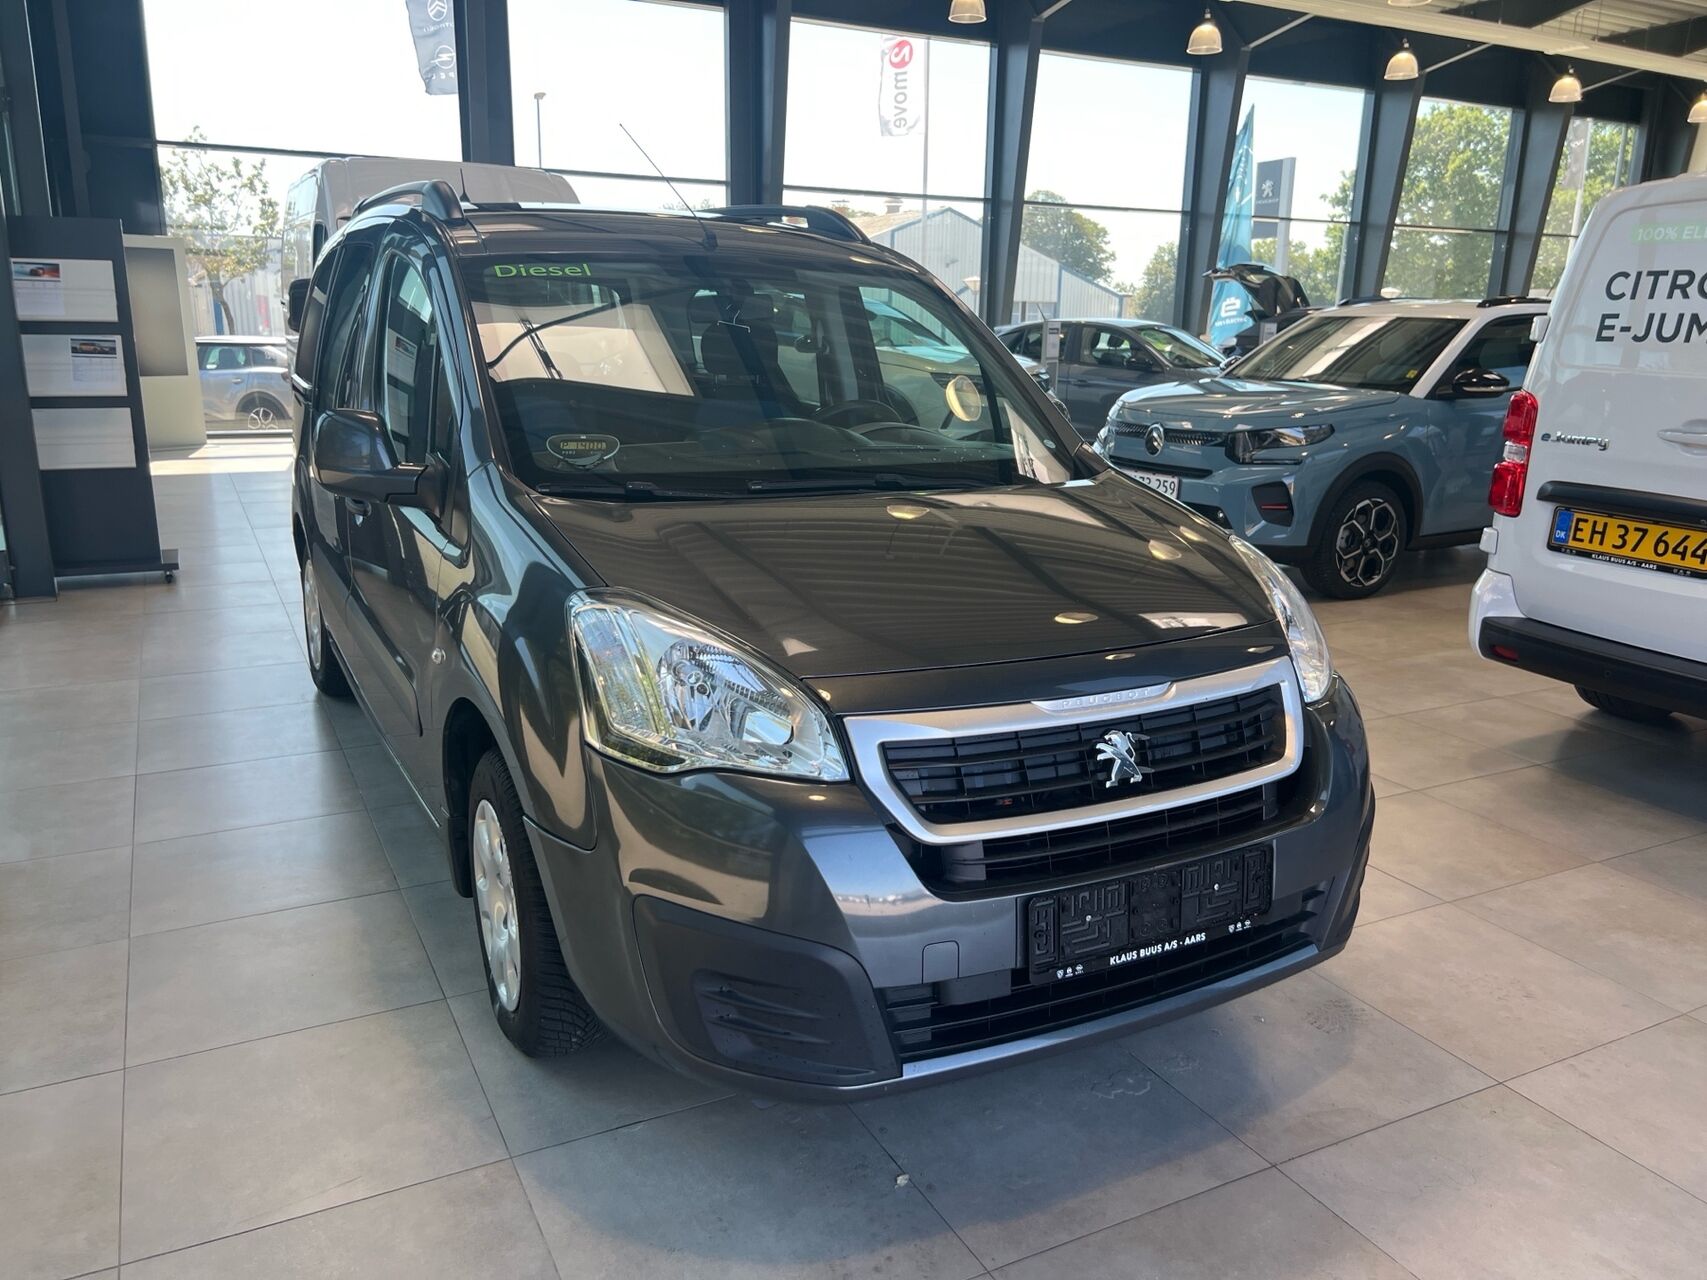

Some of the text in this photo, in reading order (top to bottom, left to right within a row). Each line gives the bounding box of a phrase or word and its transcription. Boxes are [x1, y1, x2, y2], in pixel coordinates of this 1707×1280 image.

[1638, 226, 1678, 241] 100%
[494, 263, 592, 278] Diesel
[1155, 478, 1176, 495] 259
[1555, 529, 1566, 540] DK
[1571, 517, 1707, 565] EH 37 644
[1591, 553, 1610, 562] KLAUS
[1610, 556, 1626, 564] BUUS
[1626, 559, 1637, 567] A/S
[1641, 562, 1658, 571] AARS
[1062, 688, 1150, 708] PEUGEOT
[1109, 951, 1138, 966] KLAUS
[1139, 944, 1162, 957] BUUS
[1164, 940, 1178, 951] A/S
[1184, 932, 1206, 946] AARS
